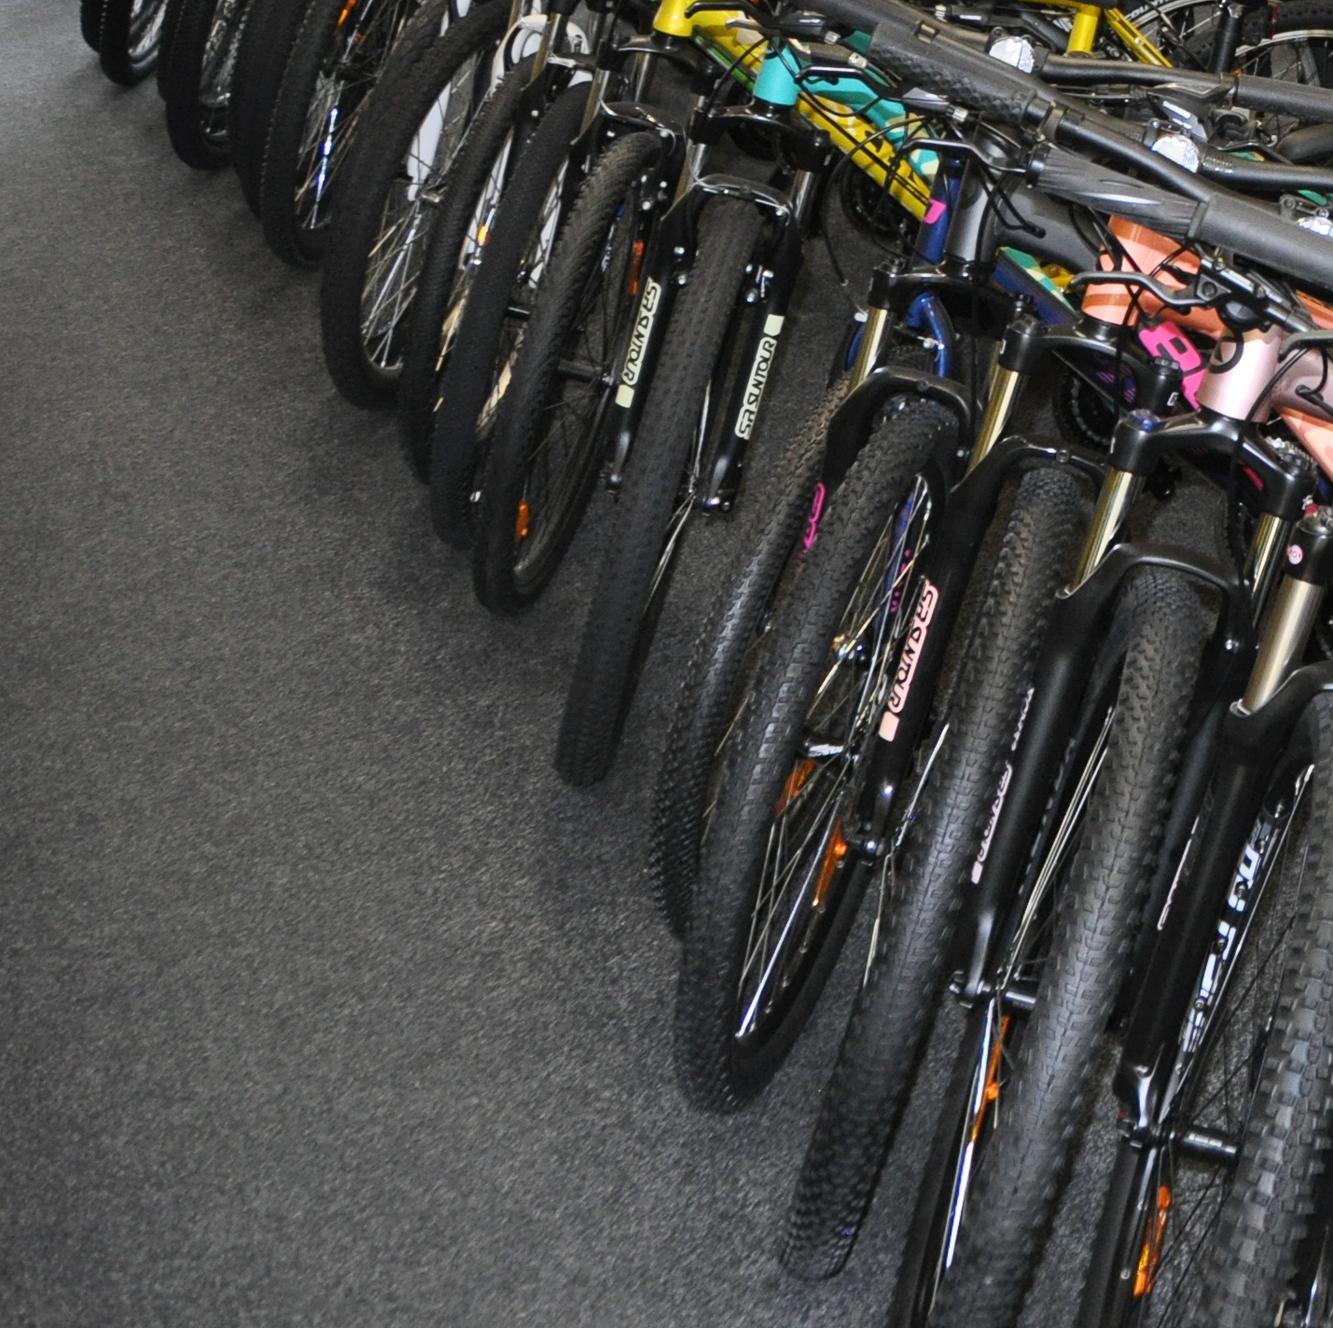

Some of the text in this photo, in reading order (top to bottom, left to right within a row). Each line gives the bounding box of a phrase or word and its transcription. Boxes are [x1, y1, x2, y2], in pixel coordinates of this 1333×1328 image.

[624, 284, 661, 382] SR SUNTOUR
[740, 338, 778, 439] SR SUNTOUR
[890, 589, 935, 708] SR SUNTOUR
